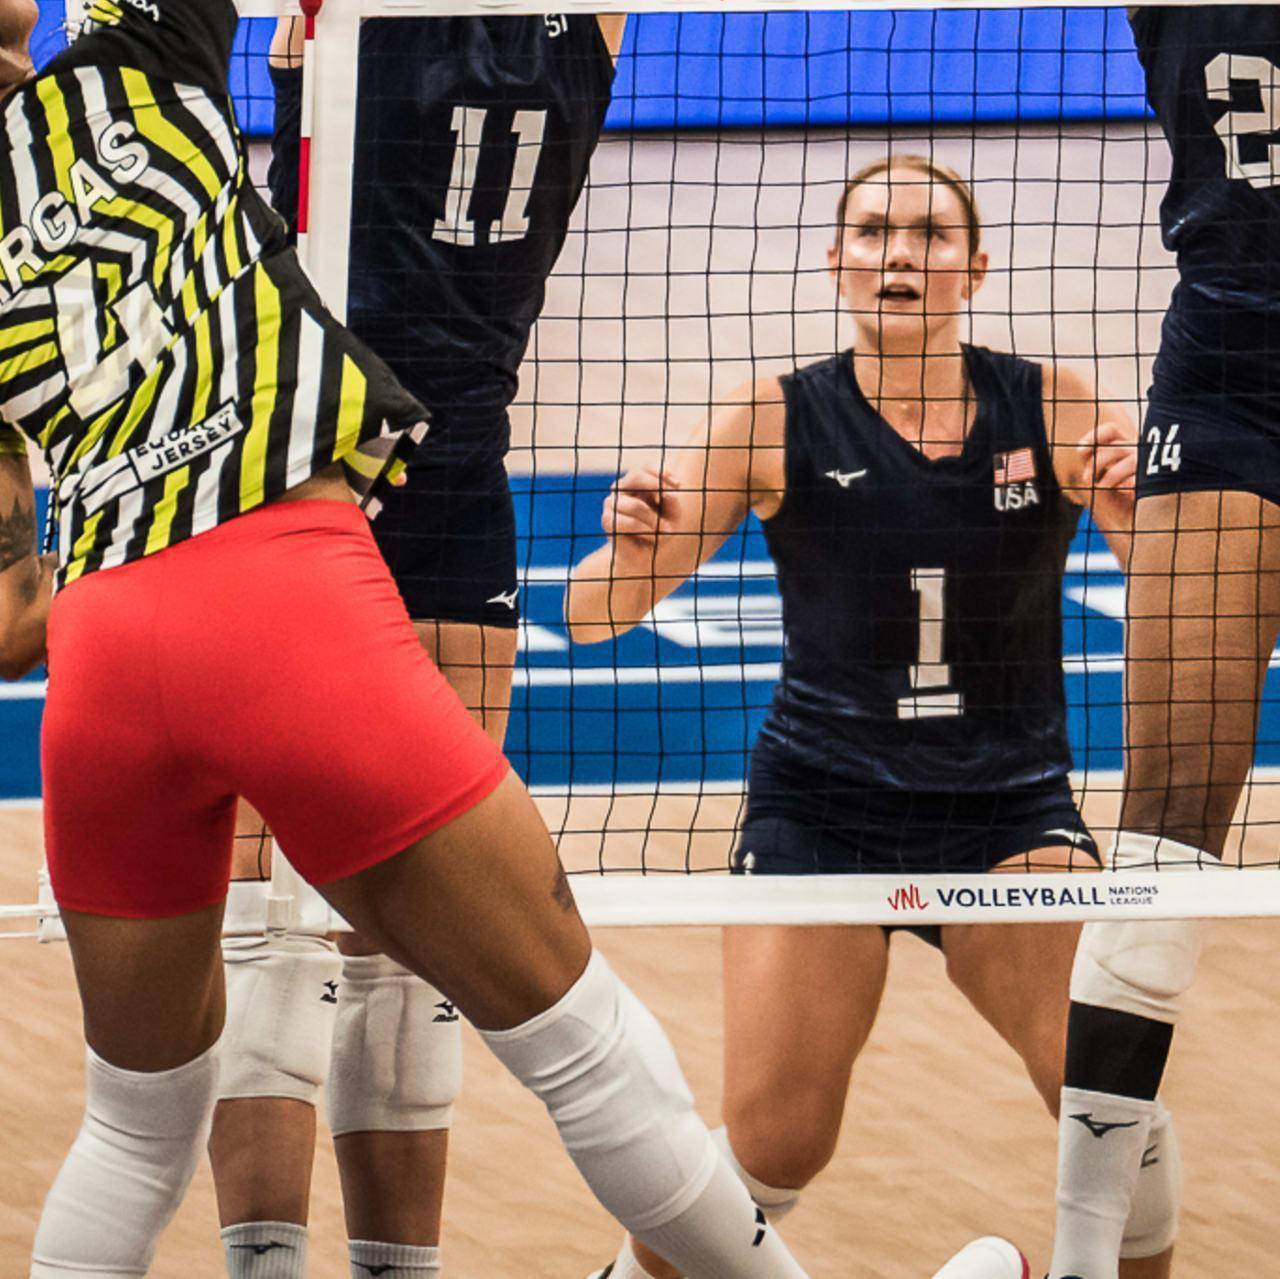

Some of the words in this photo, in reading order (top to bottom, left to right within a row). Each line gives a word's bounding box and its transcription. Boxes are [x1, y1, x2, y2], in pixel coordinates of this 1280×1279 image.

[431, 105, 548, 247] 11
[150, 416, 232, 471] JERSEY
[1145, 423, 1182, 476] 24
[993, 483, 1040, 511] USA
[896, 567, 966, 720] 1
[887, 883, 930, 911] VNL
[936, 886, 1107, 908] VOLLEYBALL
[1108, 885, 1159, 896] NATIONS
